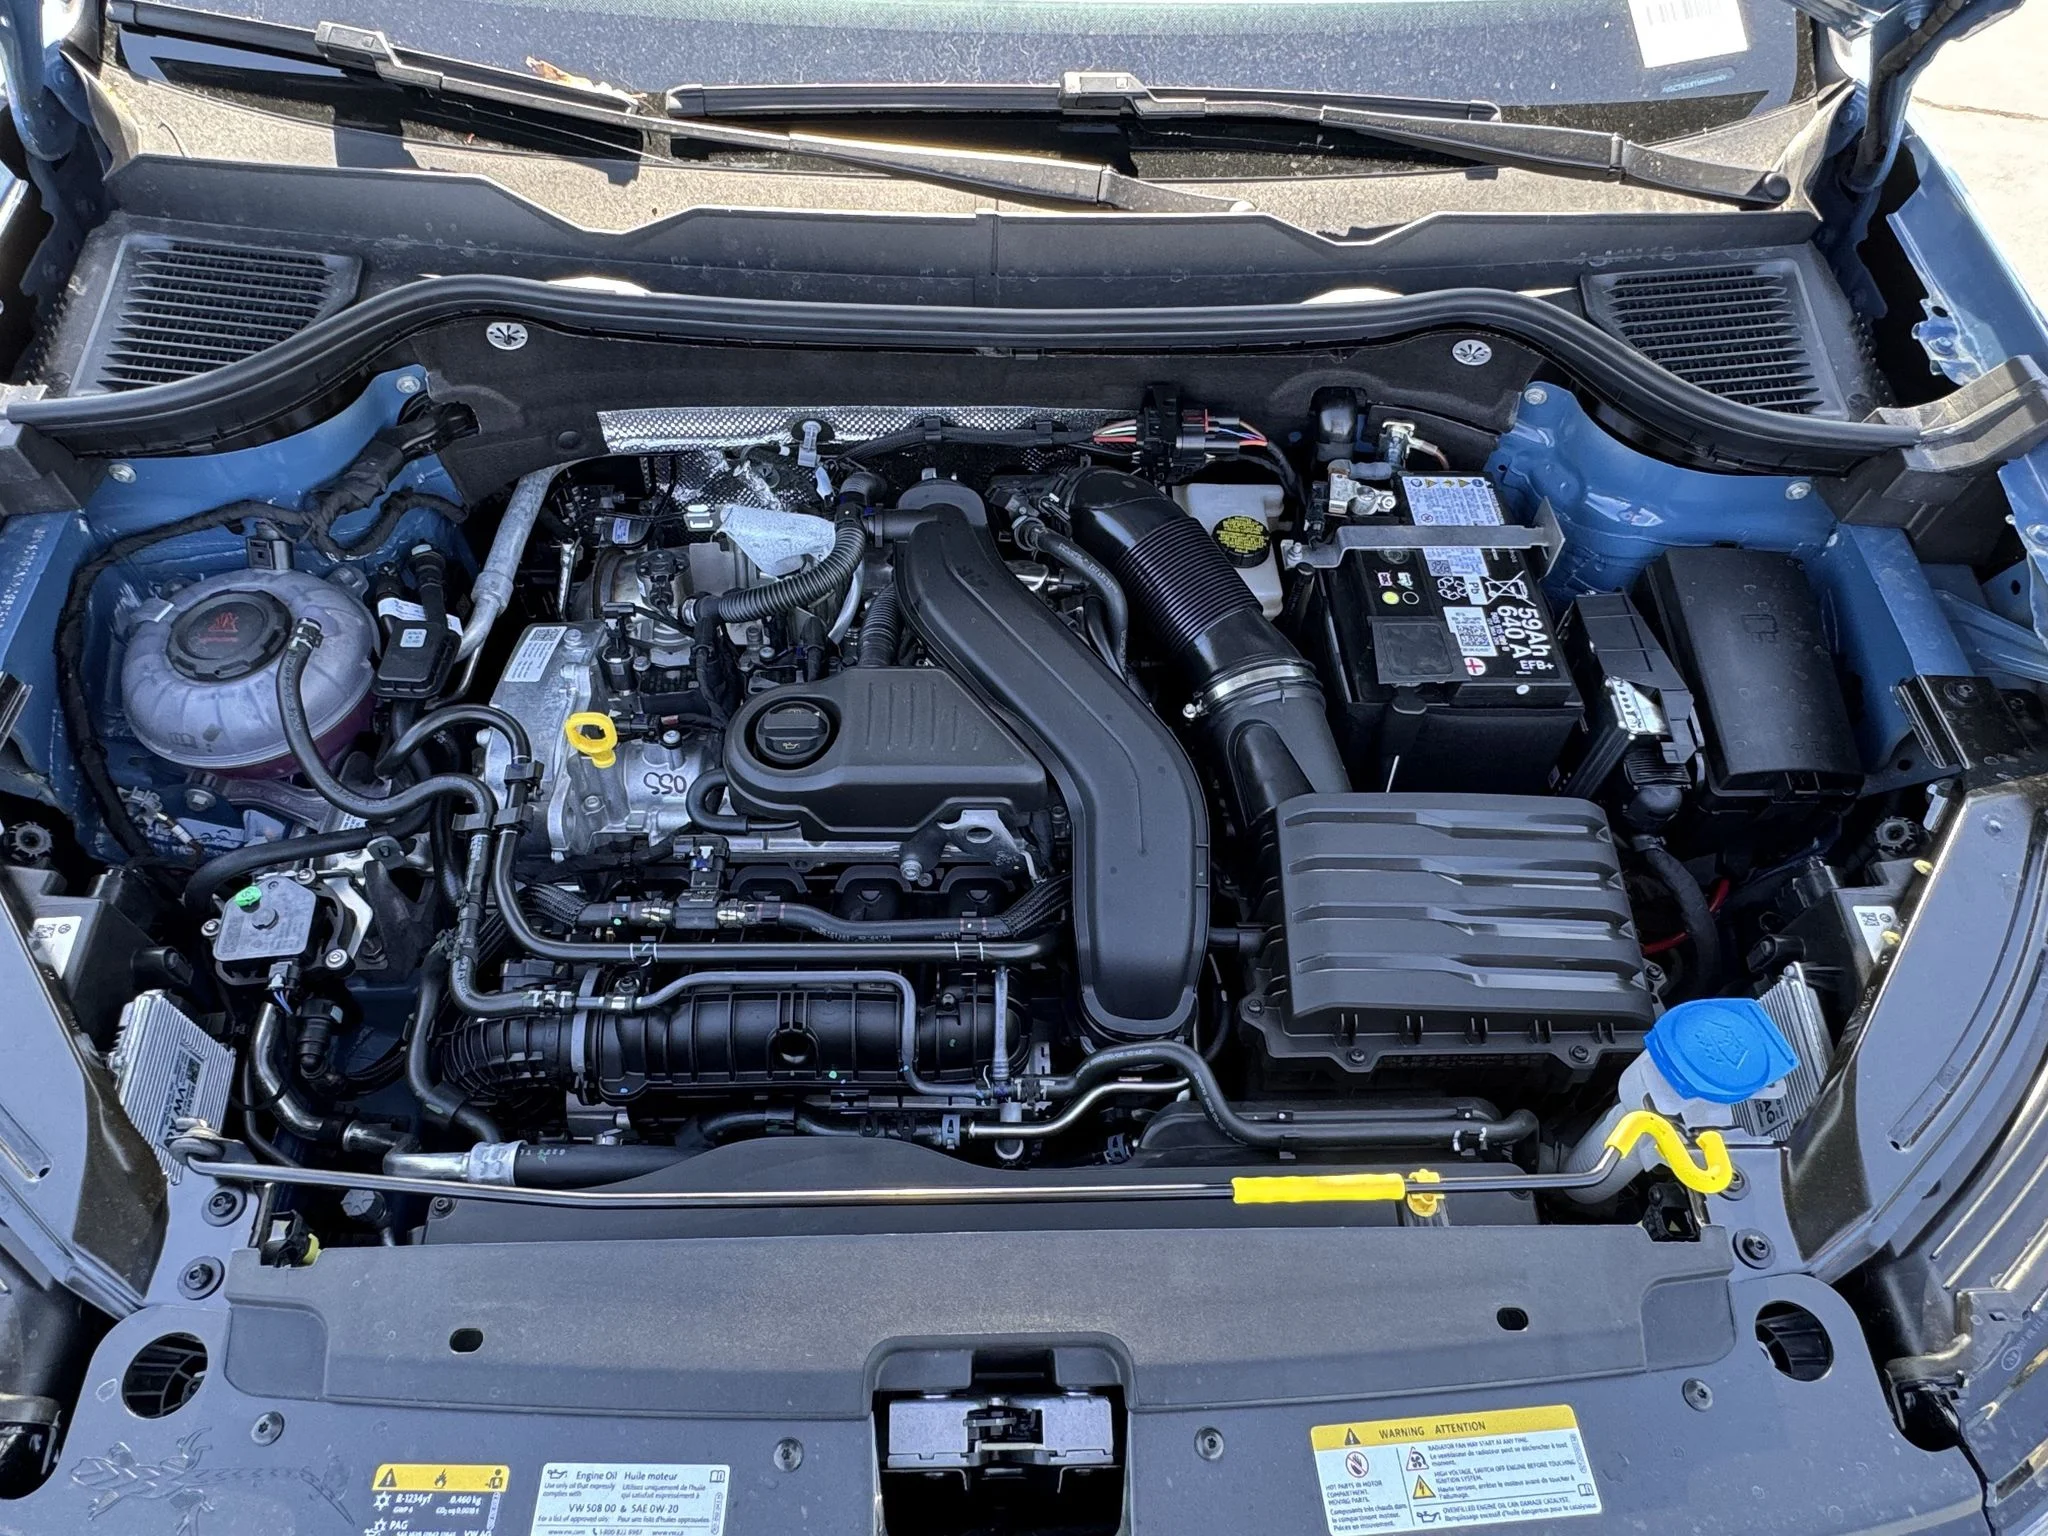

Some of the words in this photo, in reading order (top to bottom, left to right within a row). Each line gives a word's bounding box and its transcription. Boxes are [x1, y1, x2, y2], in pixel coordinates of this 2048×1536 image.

[1469, 581, 1480, 594] Pb
[1497, 605, 1526, 640] 640
[1518, 607, 1552, 656] 59Ah
[1508, 643, 1533, 659] A
[1519, 660, 1555, 670] EFB+
[173, 1088, 186, 1116] VW
[1378, 1426, 1425, 1440] WARNING
[1434, 1420, 1486, 1434] ATTENTION
[1434, 1470, 1448, 1478] HIGH
[1473, 1466, 1494, 1474] SWITCH
[1528, 1462, 1548, 1470] BEFORE
[1548, 1460, 1576, 1468] TOUCHING
[576, 1470, 604, 1482] Engine
[605, 1471, 618, 1480] Oil
[624, 1472, 646, 1480] Huile
[648, 1472, 678, 1480] moteur
[589, 1483, 616, 1492] expressly
[1338, 1482, 1354, 1490] PARTS
[1362, 1480, 1382, 1488] MOTOR
[395, 1493, 432, 1507] R-1234yf
[472, 1496, 482, 1506] kg
[542, 1490, 568, 1498] complies
[392, 1506, 408, 1514] GWP
[568, 1504, 586, 1512] VW
[586, 1504, 602, 1512] 508
[604, 1504, 617, 1512] 00
[631, 1504, 648, 1513] SAE
[1442, 1506, 1476, 1514] OVERFILLED
[388, 1520, 408, 1530] PAG
